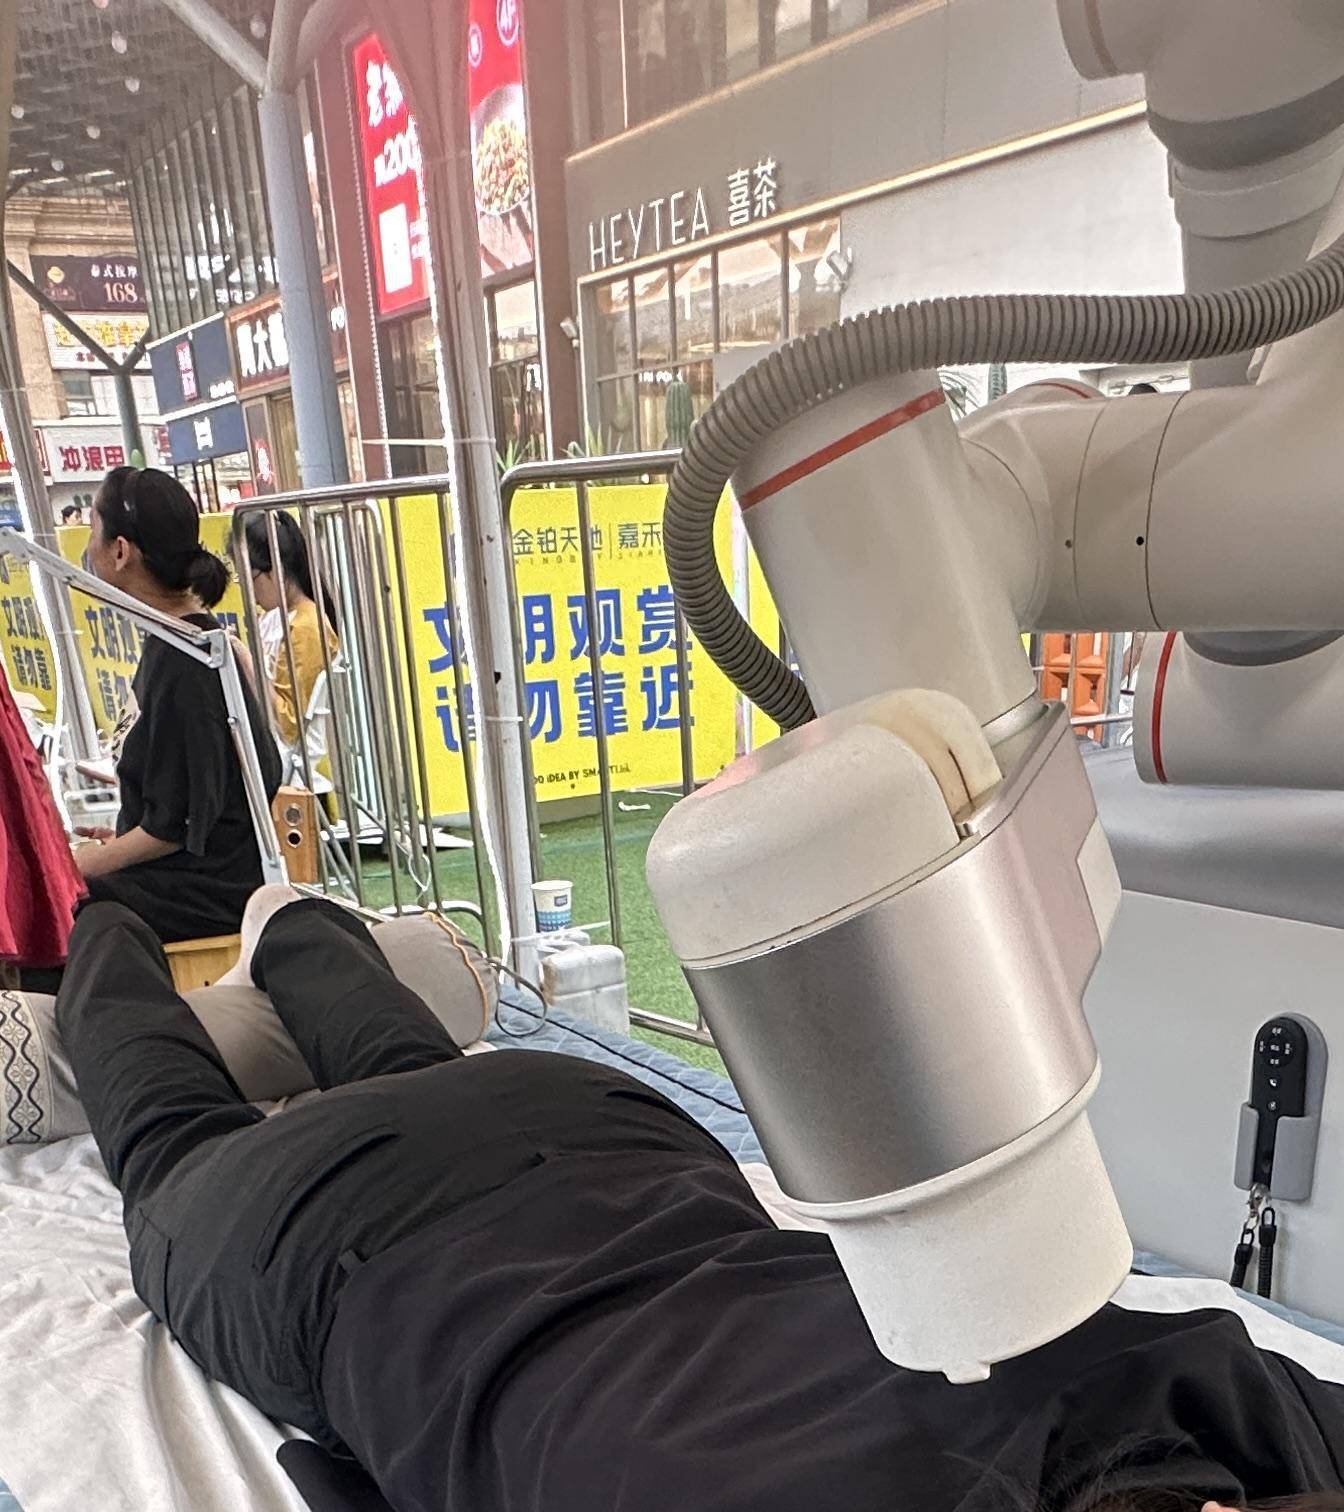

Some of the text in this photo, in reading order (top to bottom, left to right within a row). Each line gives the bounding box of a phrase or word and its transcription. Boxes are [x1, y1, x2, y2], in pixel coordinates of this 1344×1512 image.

[588, 156, 778, 273] HEYTEA 喜茶
[104, 281, 139, 304] 168
